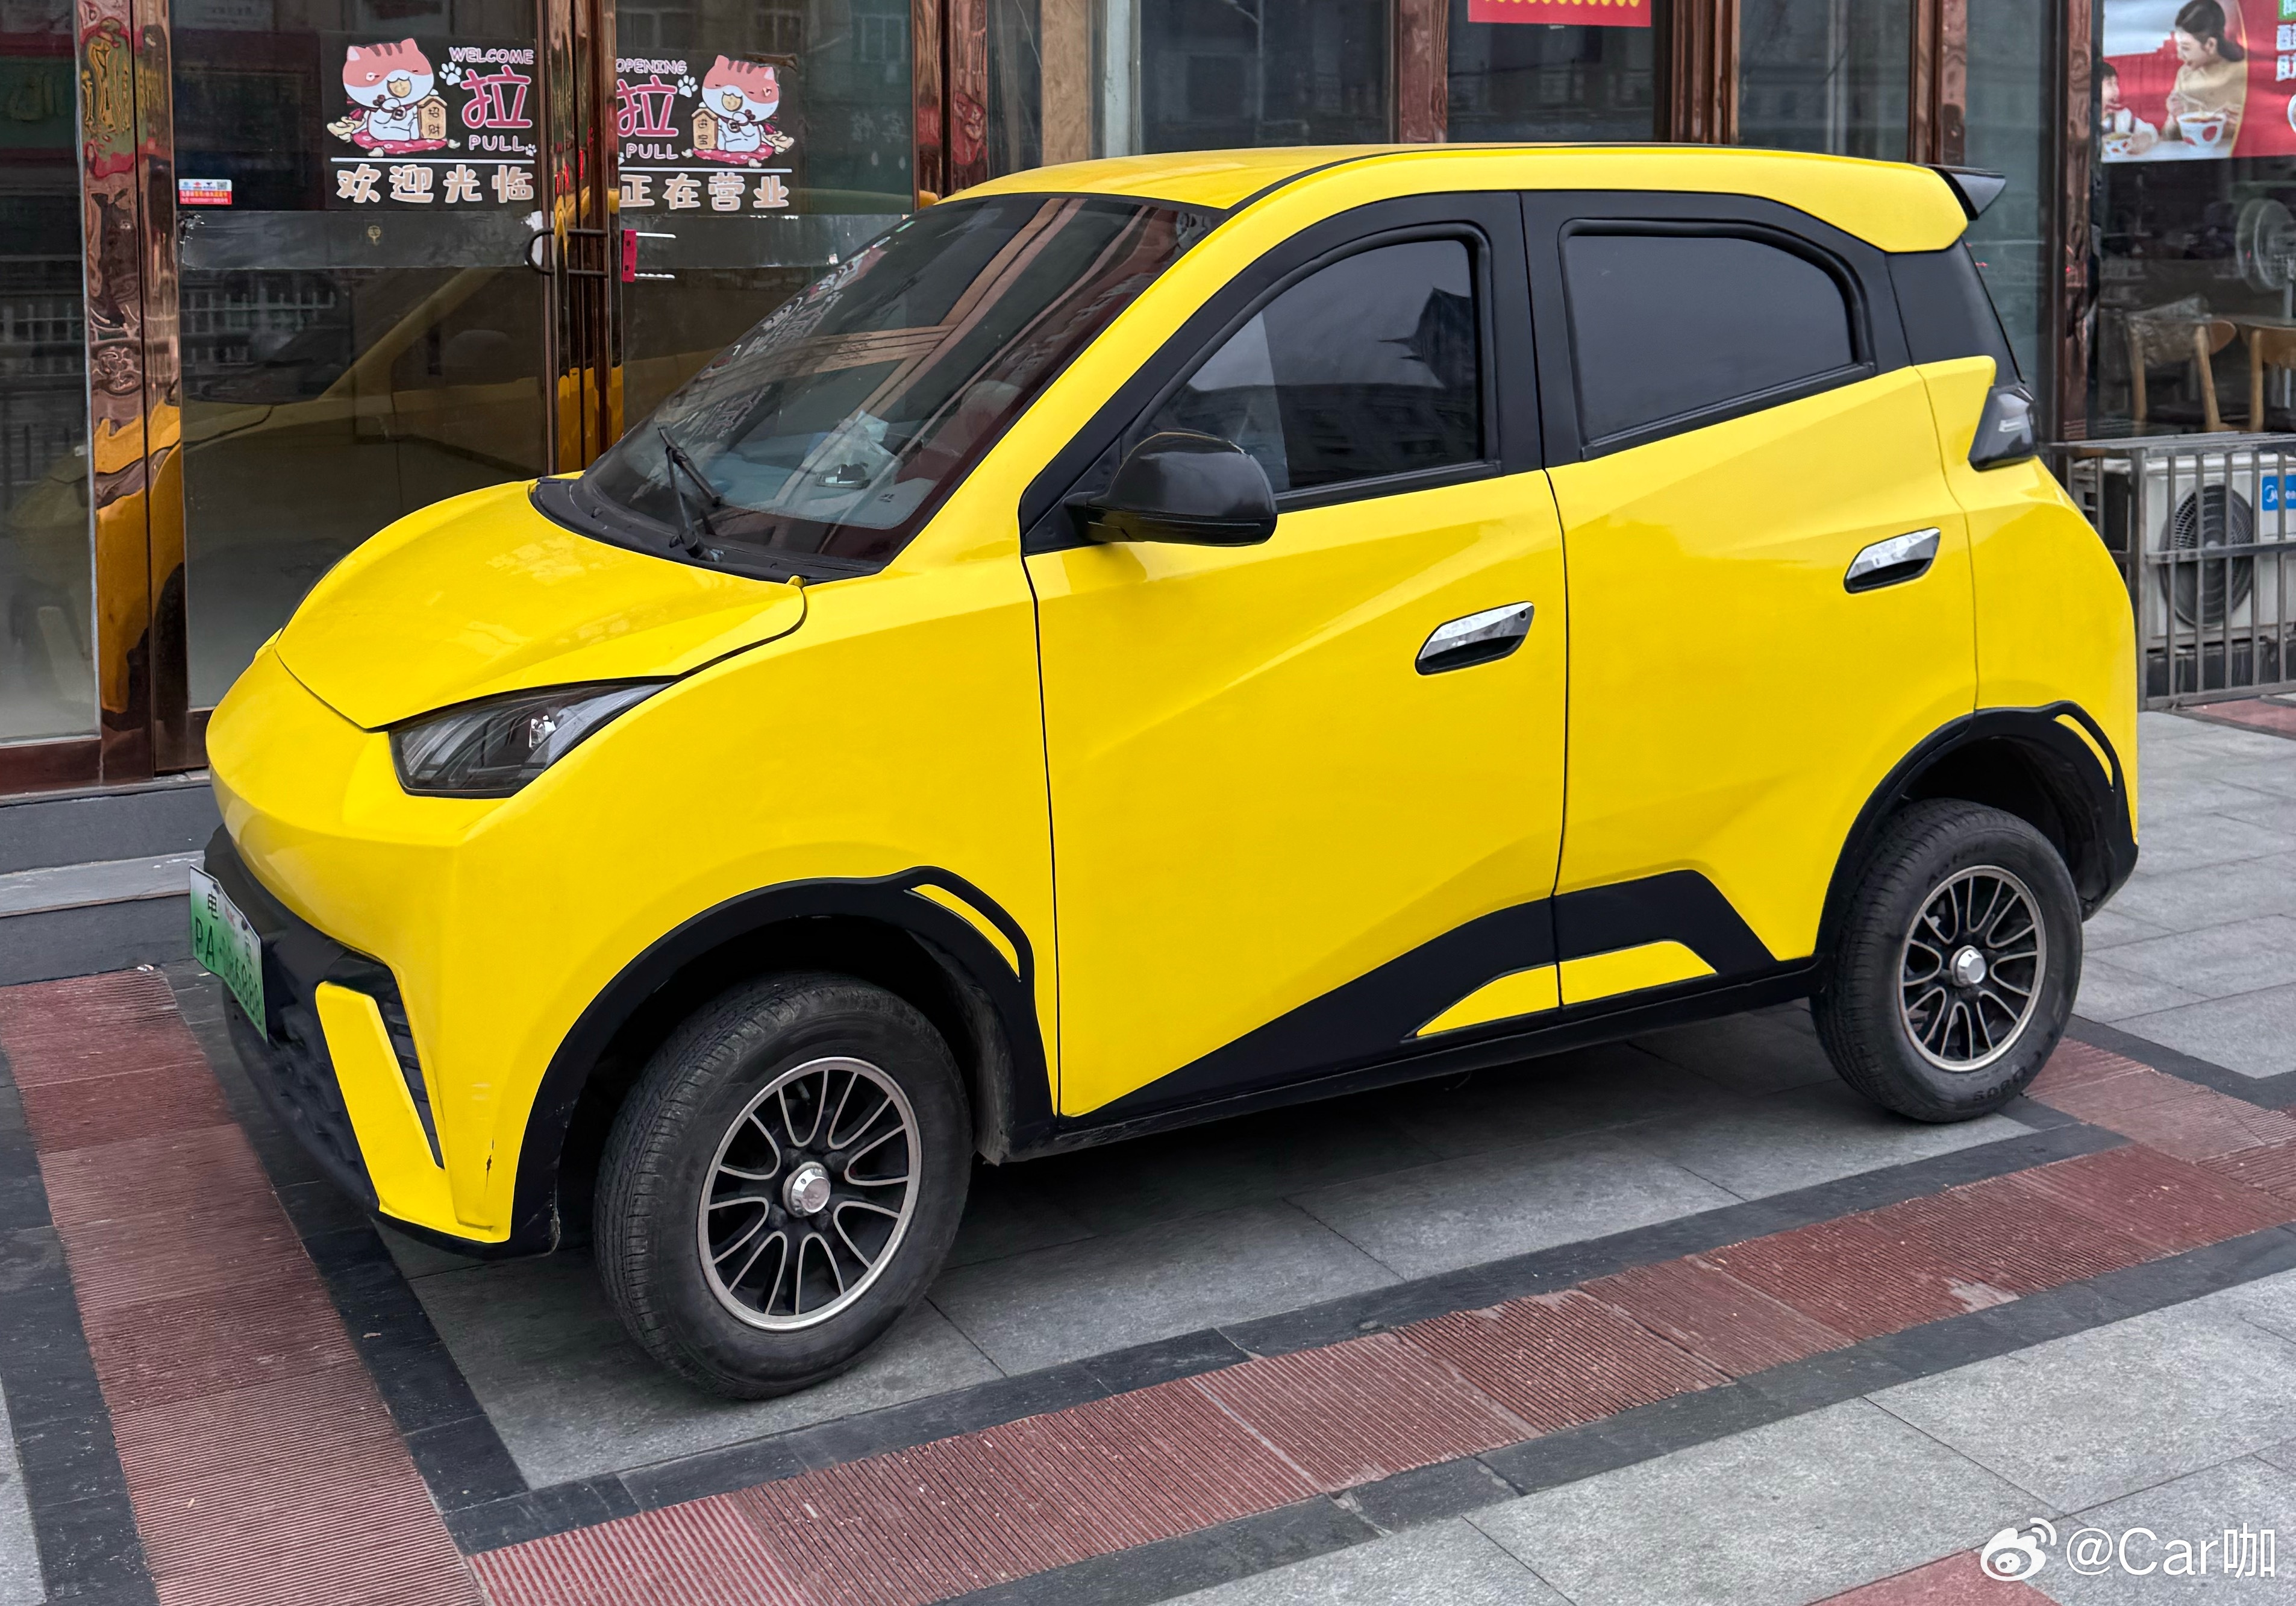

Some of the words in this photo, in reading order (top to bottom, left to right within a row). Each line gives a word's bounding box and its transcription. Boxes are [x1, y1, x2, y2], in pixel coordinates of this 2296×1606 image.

[448, 46, 534, 65] WELCOME
[616, 58, 687, 75] OPENING
[460, 64, 532, 129] 拉
[617, 74, 679, 137] 拉
[469, 135, 525, 152] PULL
[626, 143, 679, 160] PULL
[336, 163, 534, 204] 欢迎光临
[619, 172, 790, 212] 正在营业
